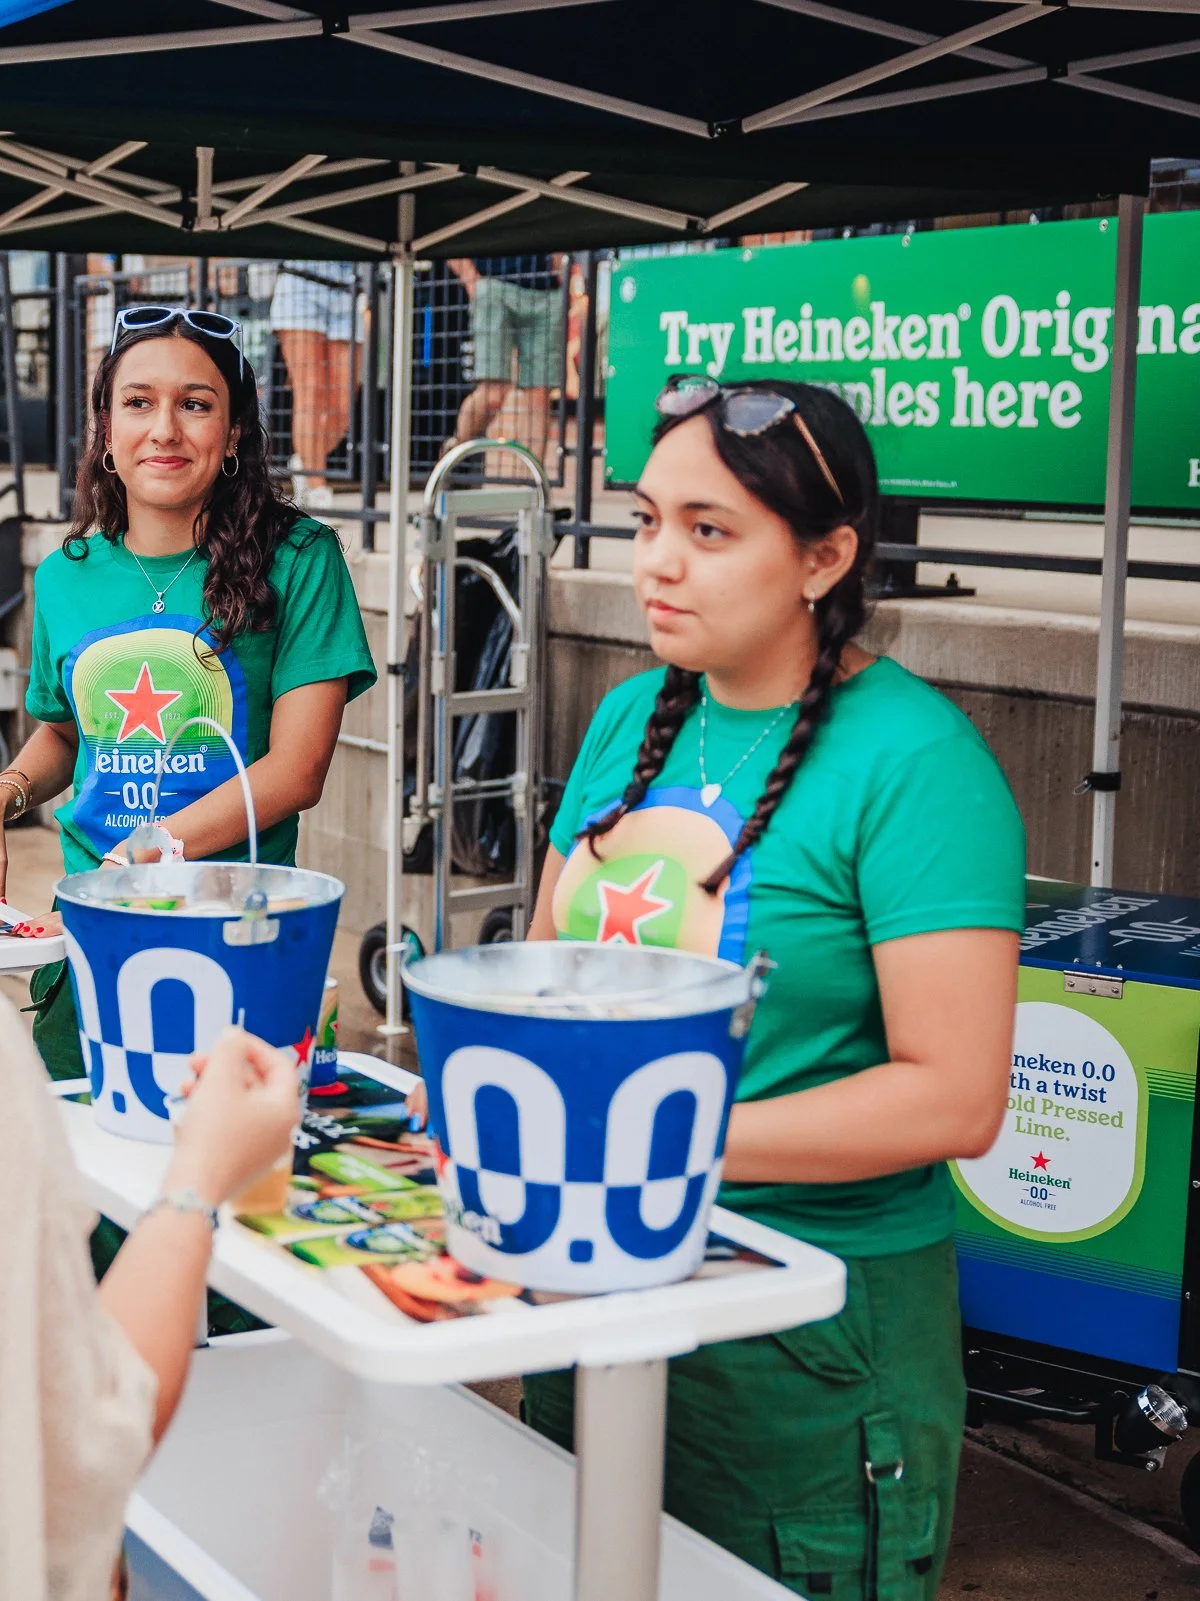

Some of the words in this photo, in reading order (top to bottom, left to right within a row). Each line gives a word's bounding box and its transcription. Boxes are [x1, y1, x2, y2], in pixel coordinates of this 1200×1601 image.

[660, 311, 735, 378] Try
[981, 290, 1200, 373] Origna
[812, 367, 940, 428] ples
[949, 366, 1083, 429] here
[1019, 896, 1159, 951] eineken
[1010, 1053, 1076, 1077] neken
[1082, 1060, 1116, 1083] 0.0
[1009, 1071, 1031, 1092] th
[1036, 1079, 1048, 1094] a
[1053, 1079, 1108, 1104] twist
[1006, 1093, 1036, 1114] old
[1041, 1097, 1124, 1129] Pressed
[1015, 1115, 1071, 1142] Lime.
[441, 1044, 728, 1264] 0.0
[1020, 1198, 1043, 1209] ALCOHOL
[1044, 1202, 1057, 1212] FREE
